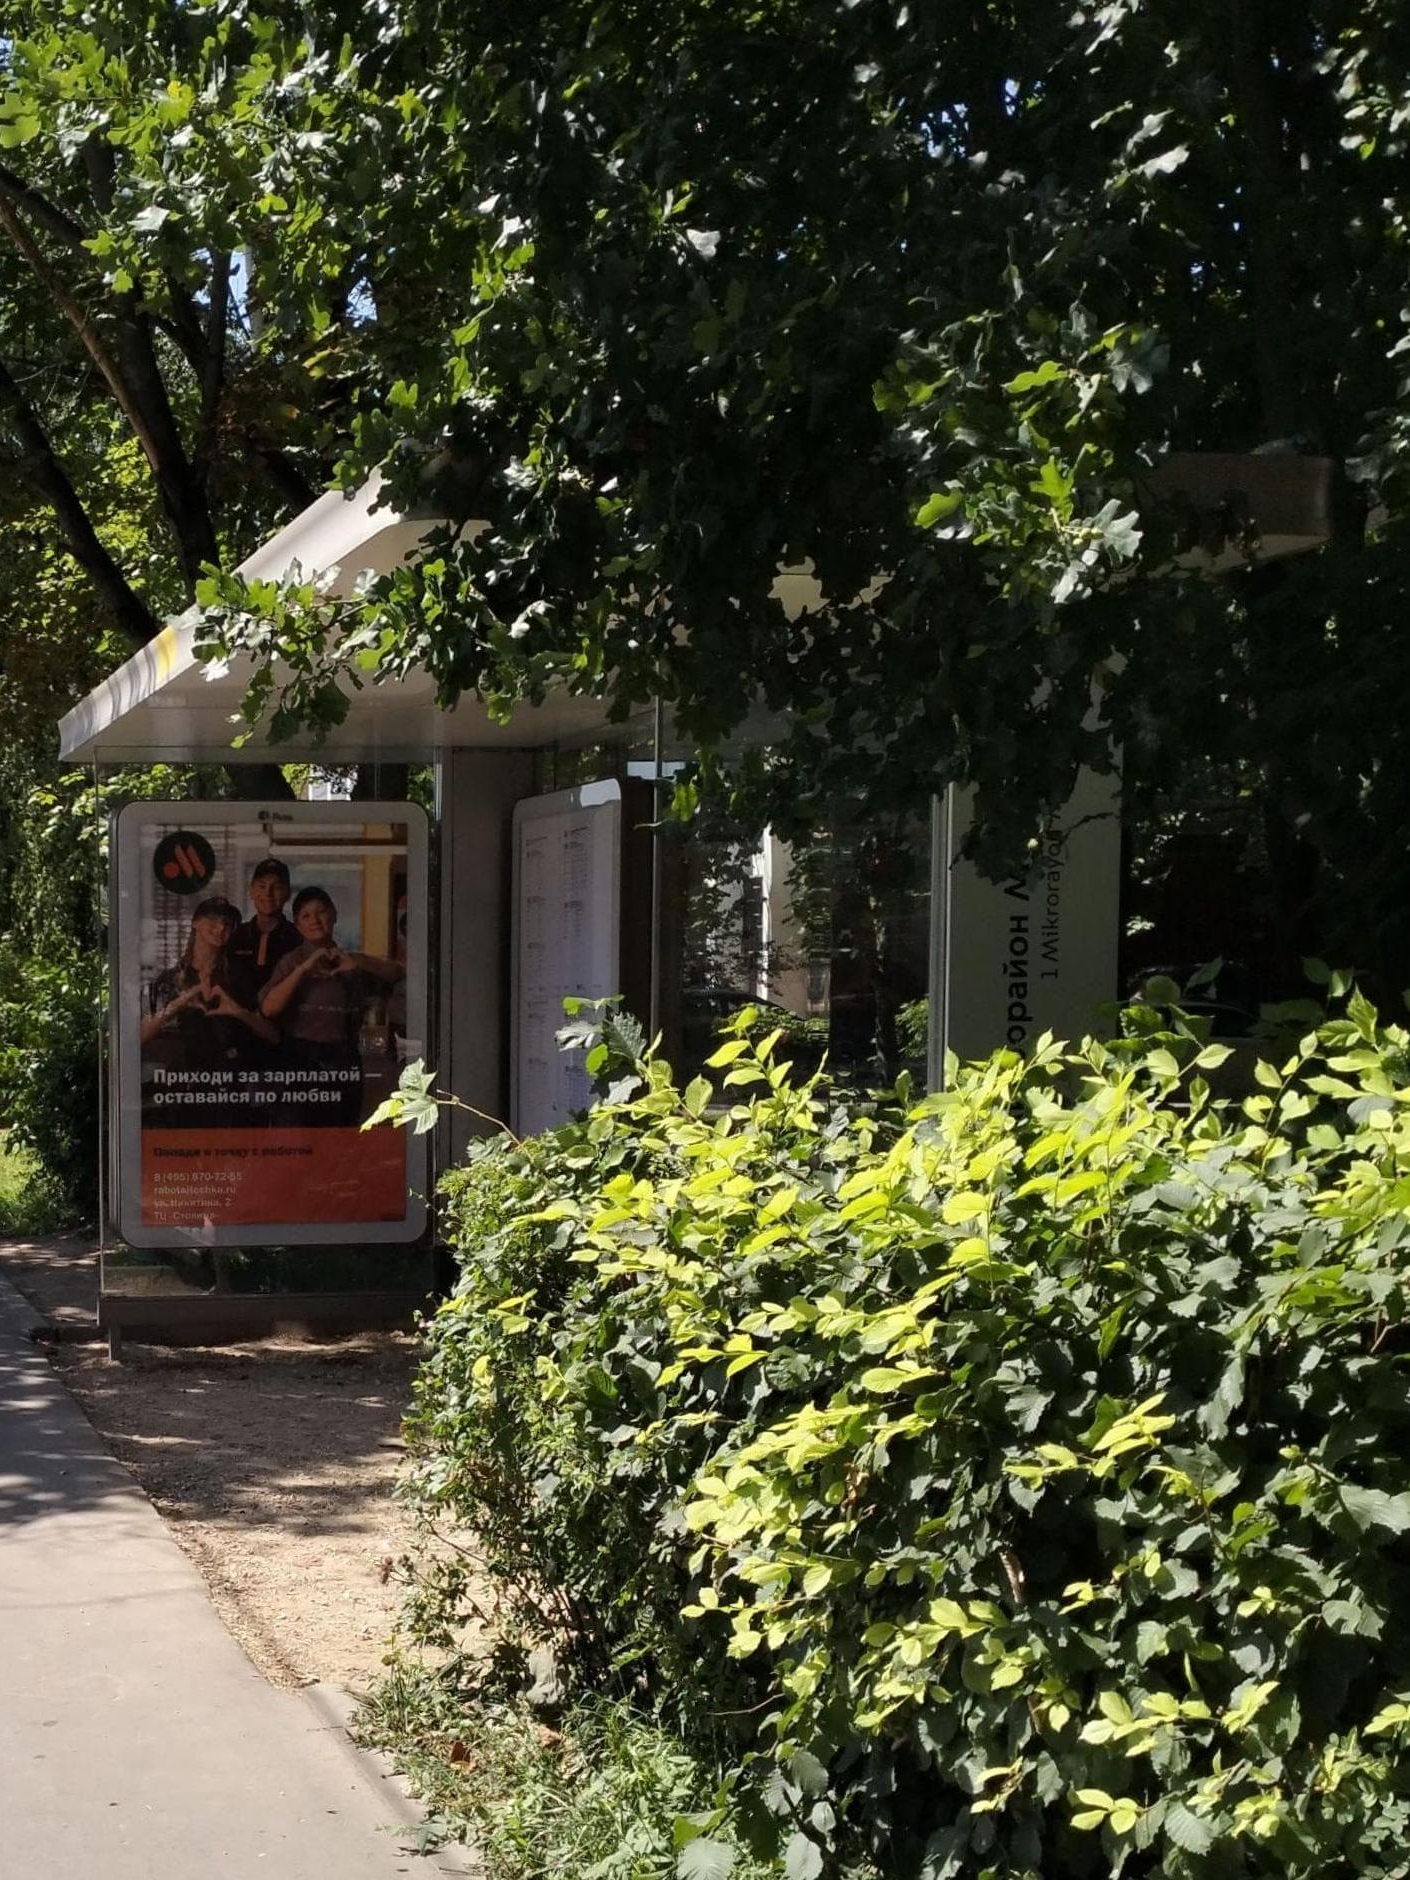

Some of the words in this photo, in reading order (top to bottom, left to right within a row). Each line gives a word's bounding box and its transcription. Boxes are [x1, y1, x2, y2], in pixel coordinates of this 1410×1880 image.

[1041, 968, 1058, 979] 1
[1002, 915, 1033, 1058] орайон
[153, 1069, 234, 1085] Приходи
[238, 1071, 259, 1083] за
[264, 1066, 361, 1084] зарплатой
[153, 1088, 250, 1104] оставайся
[255, 1091, 277, 1103] по
[281, 1087, 342, 1103] любви
